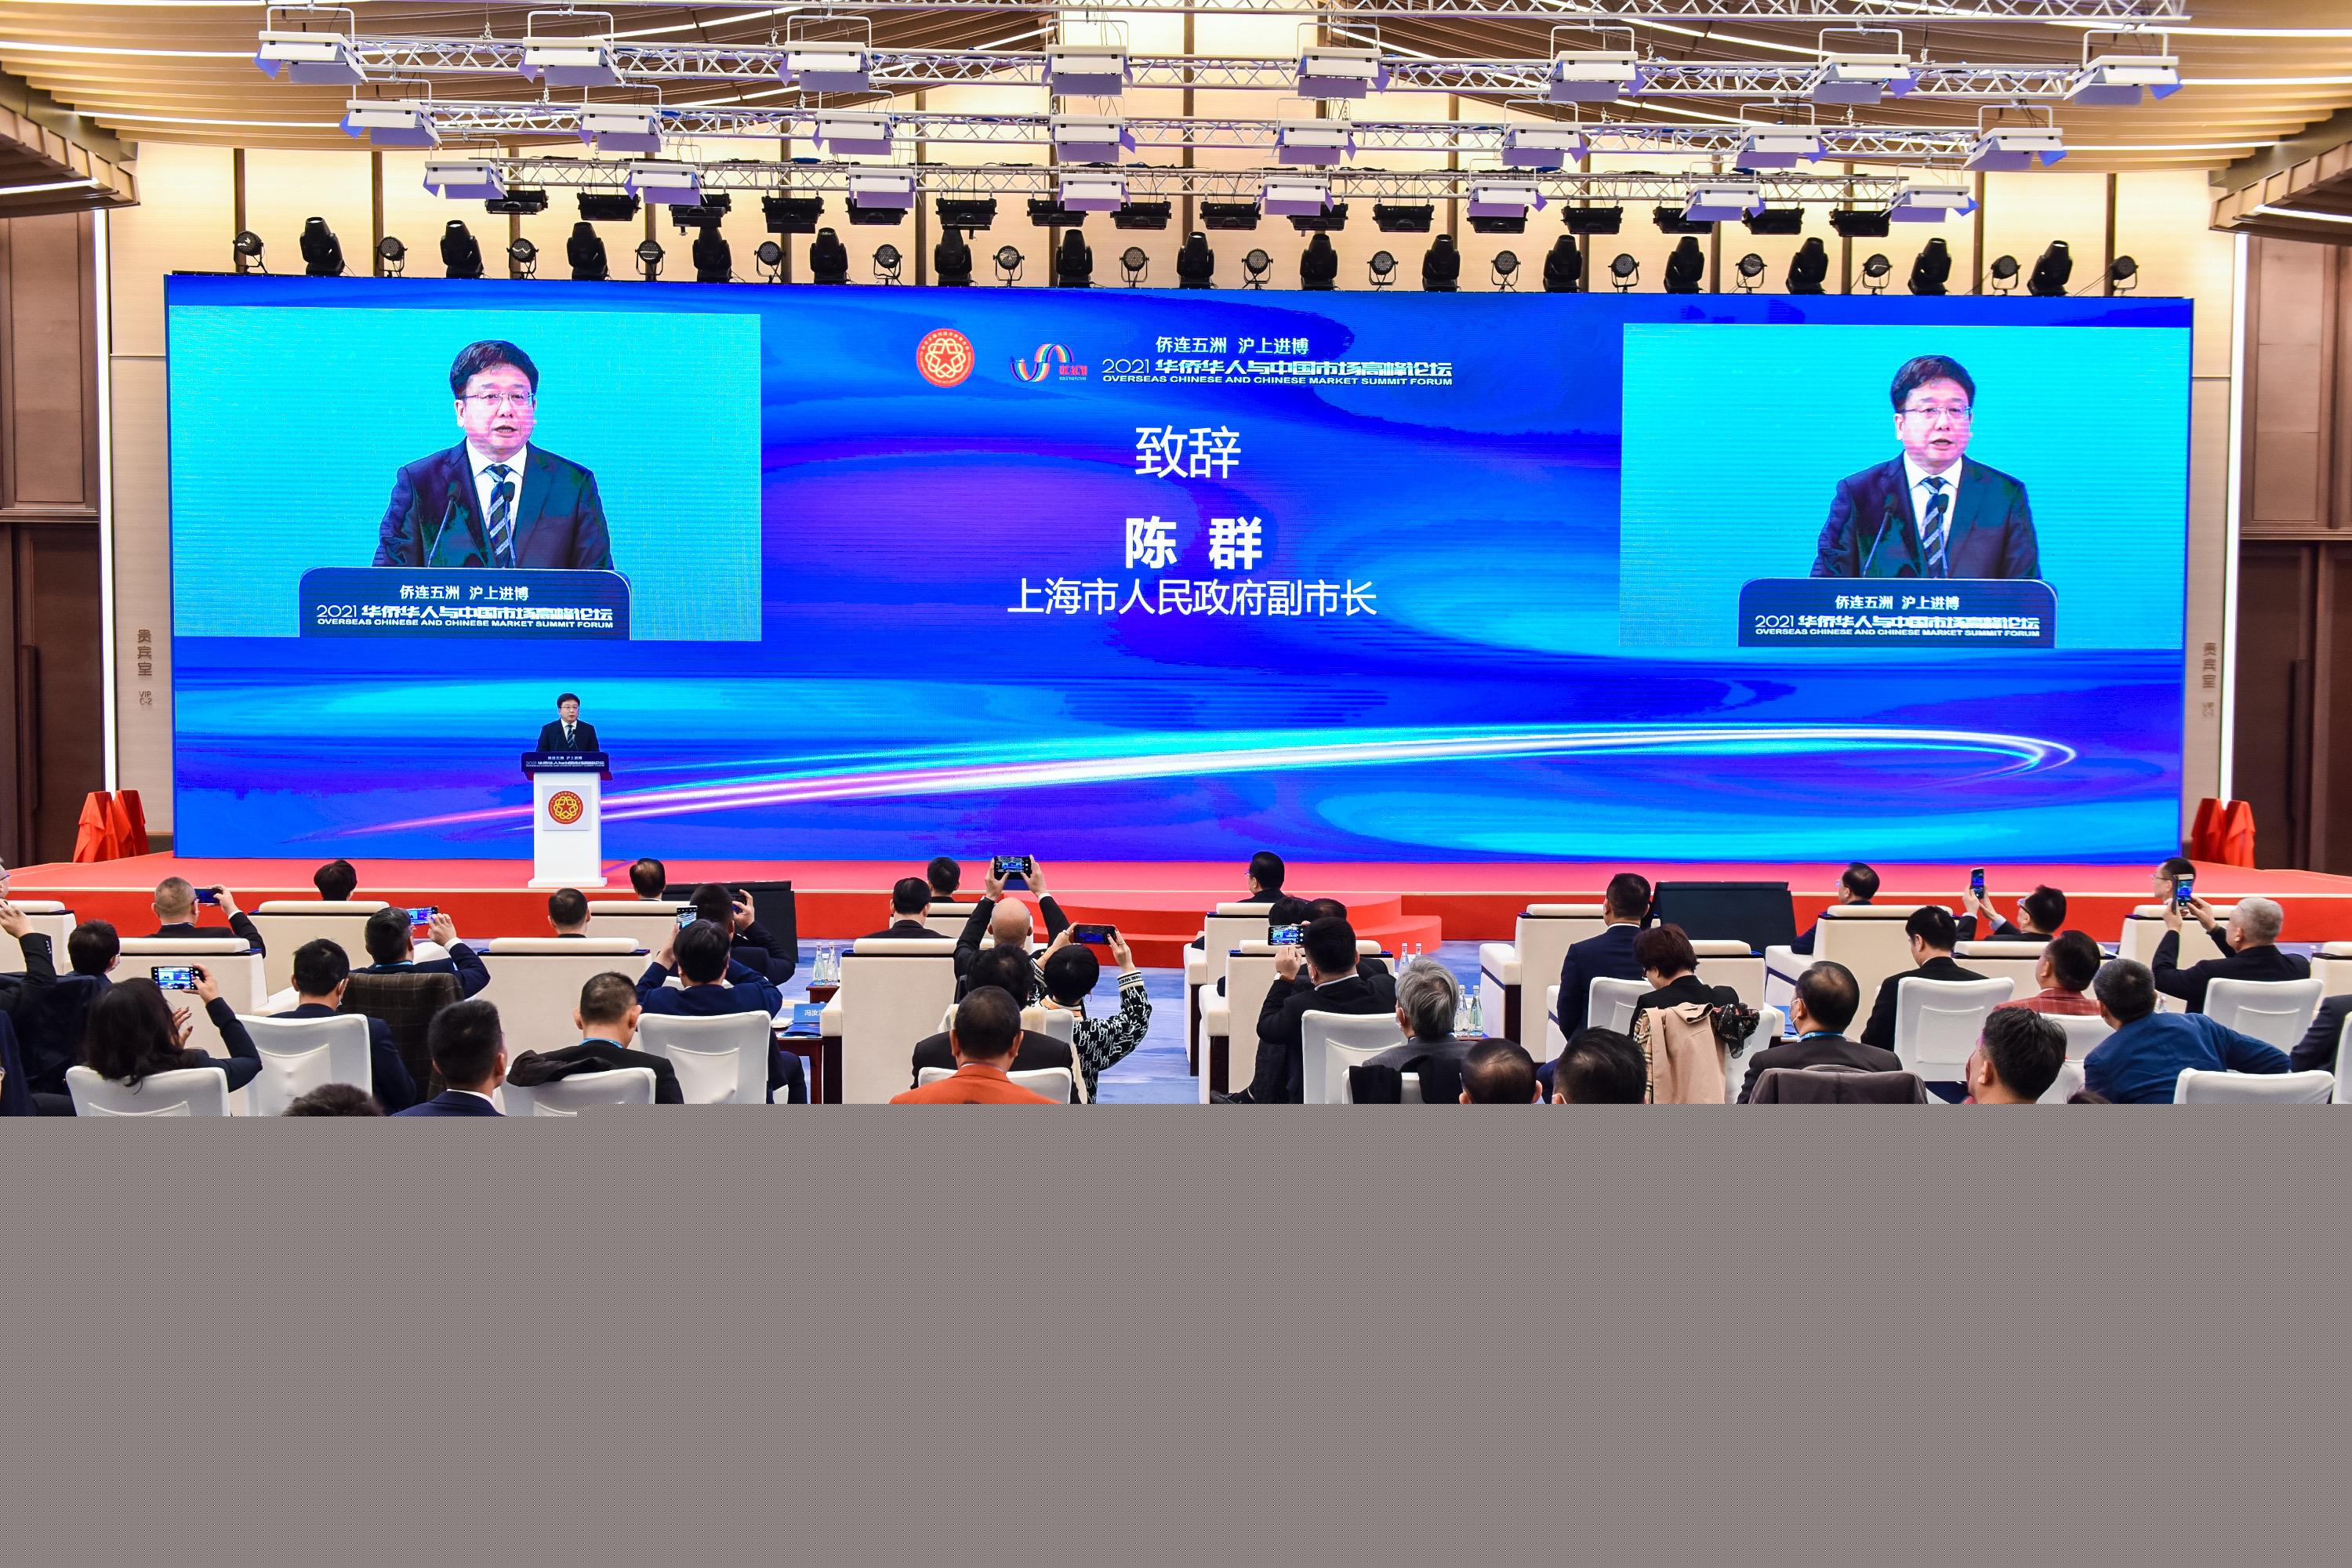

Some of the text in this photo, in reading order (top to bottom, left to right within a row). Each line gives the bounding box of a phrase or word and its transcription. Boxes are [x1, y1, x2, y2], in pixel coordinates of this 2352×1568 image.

[1156, 336, 1308, 355] 侨连五洲 沪上进博
[1102, 358, 1453, 376] 2021 华侨华人与中国市场高峰论坛
[1253, 376, 1307, 385] CHINESE
[1134, 424, 1242, 479] 致辞
[1126, 516, 1263, 570] 陈 群
[400, 584, 529, 601] 侨连五洲 沪上进博
[1007, 577, 1377, 617] 上海市人民政府副市长
[1835, 594, 1960, 611] 侨连五洲 沪上进博
[316, 604, 613, 621] 2021 华侨华人与中国市场高峰论坛
[1754, 615, 1795, 628] 2021
[137, 629, 152, 676] 贵宾室
